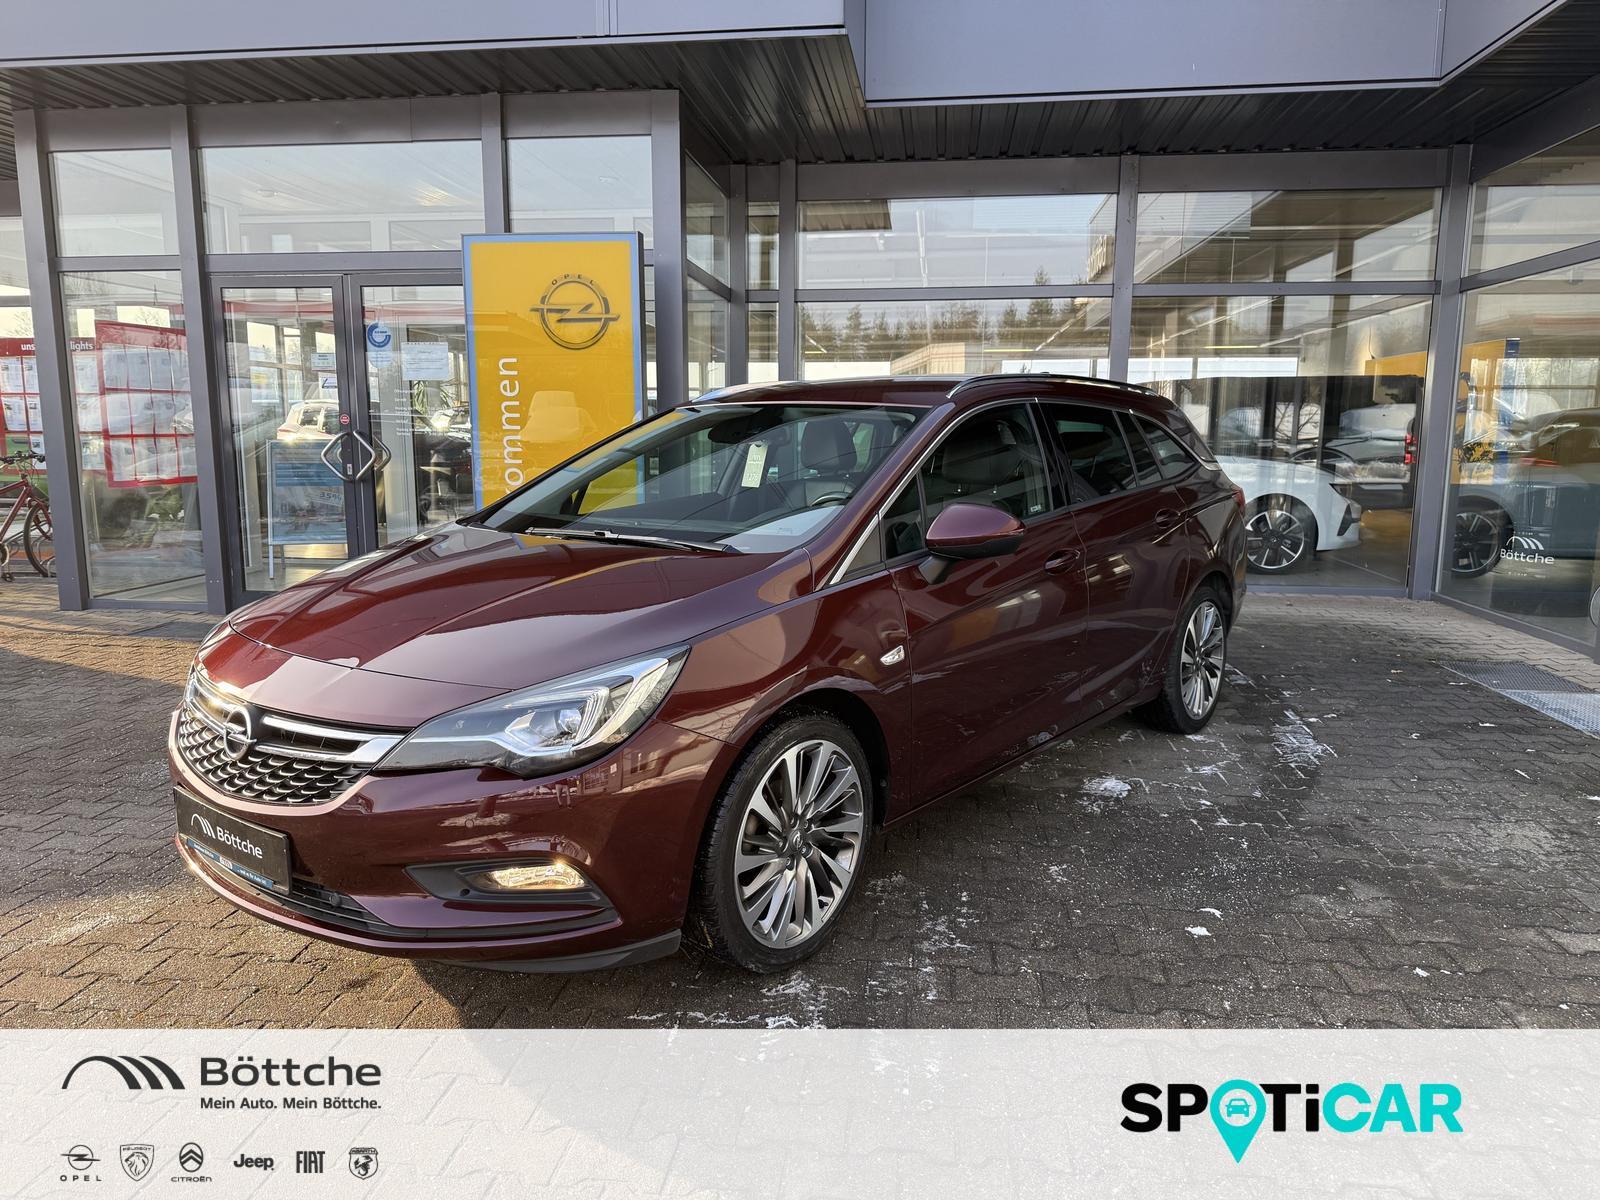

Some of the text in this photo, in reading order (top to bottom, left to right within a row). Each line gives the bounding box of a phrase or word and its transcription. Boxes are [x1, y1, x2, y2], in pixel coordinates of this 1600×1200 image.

[551, 273, 595, 286] OPEL
[1499, 549, 1555, 565] Böttche
[216, 826, 263, 859] Böttche
